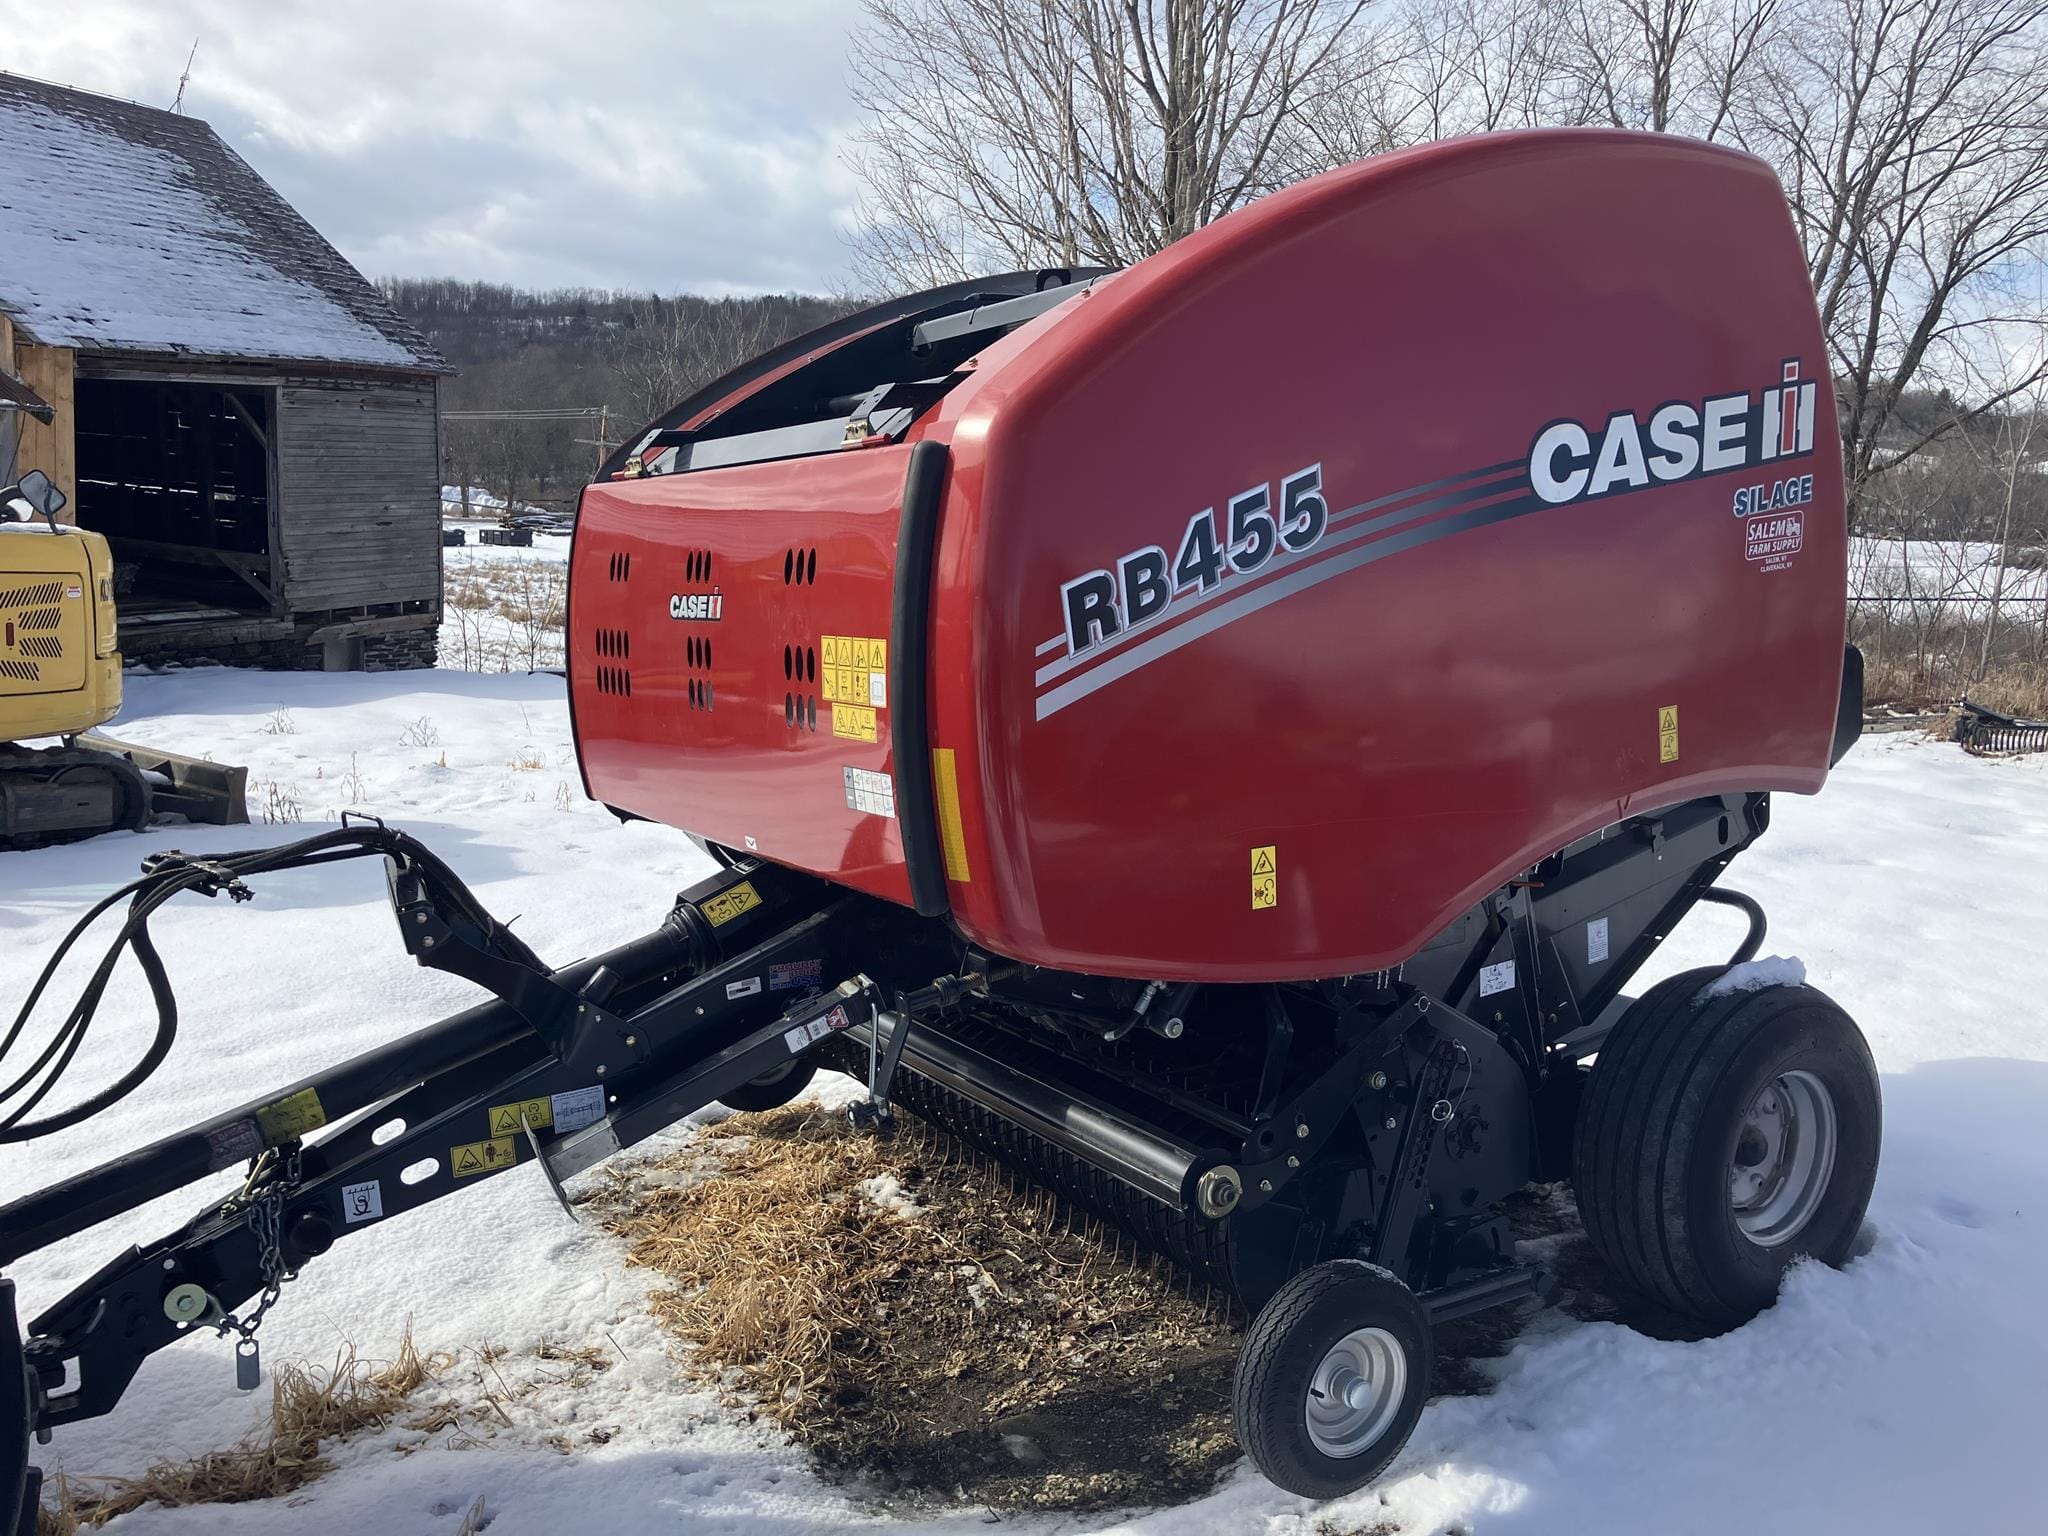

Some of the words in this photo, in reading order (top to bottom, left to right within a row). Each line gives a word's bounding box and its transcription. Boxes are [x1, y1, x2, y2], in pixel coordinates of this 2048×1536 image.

[1529, 394, 1750, 504] CASE
[1733, 474, 1813, 518] SILAGE
[1748, 519, 1786, 541] SALEM
[1748, 542, 1771, 556] FARM
[1772, 537, 1801, 552] SUPPLY
[1060, 461, 1329, 661] RB455
[670, 594, 707, 619] CASE
